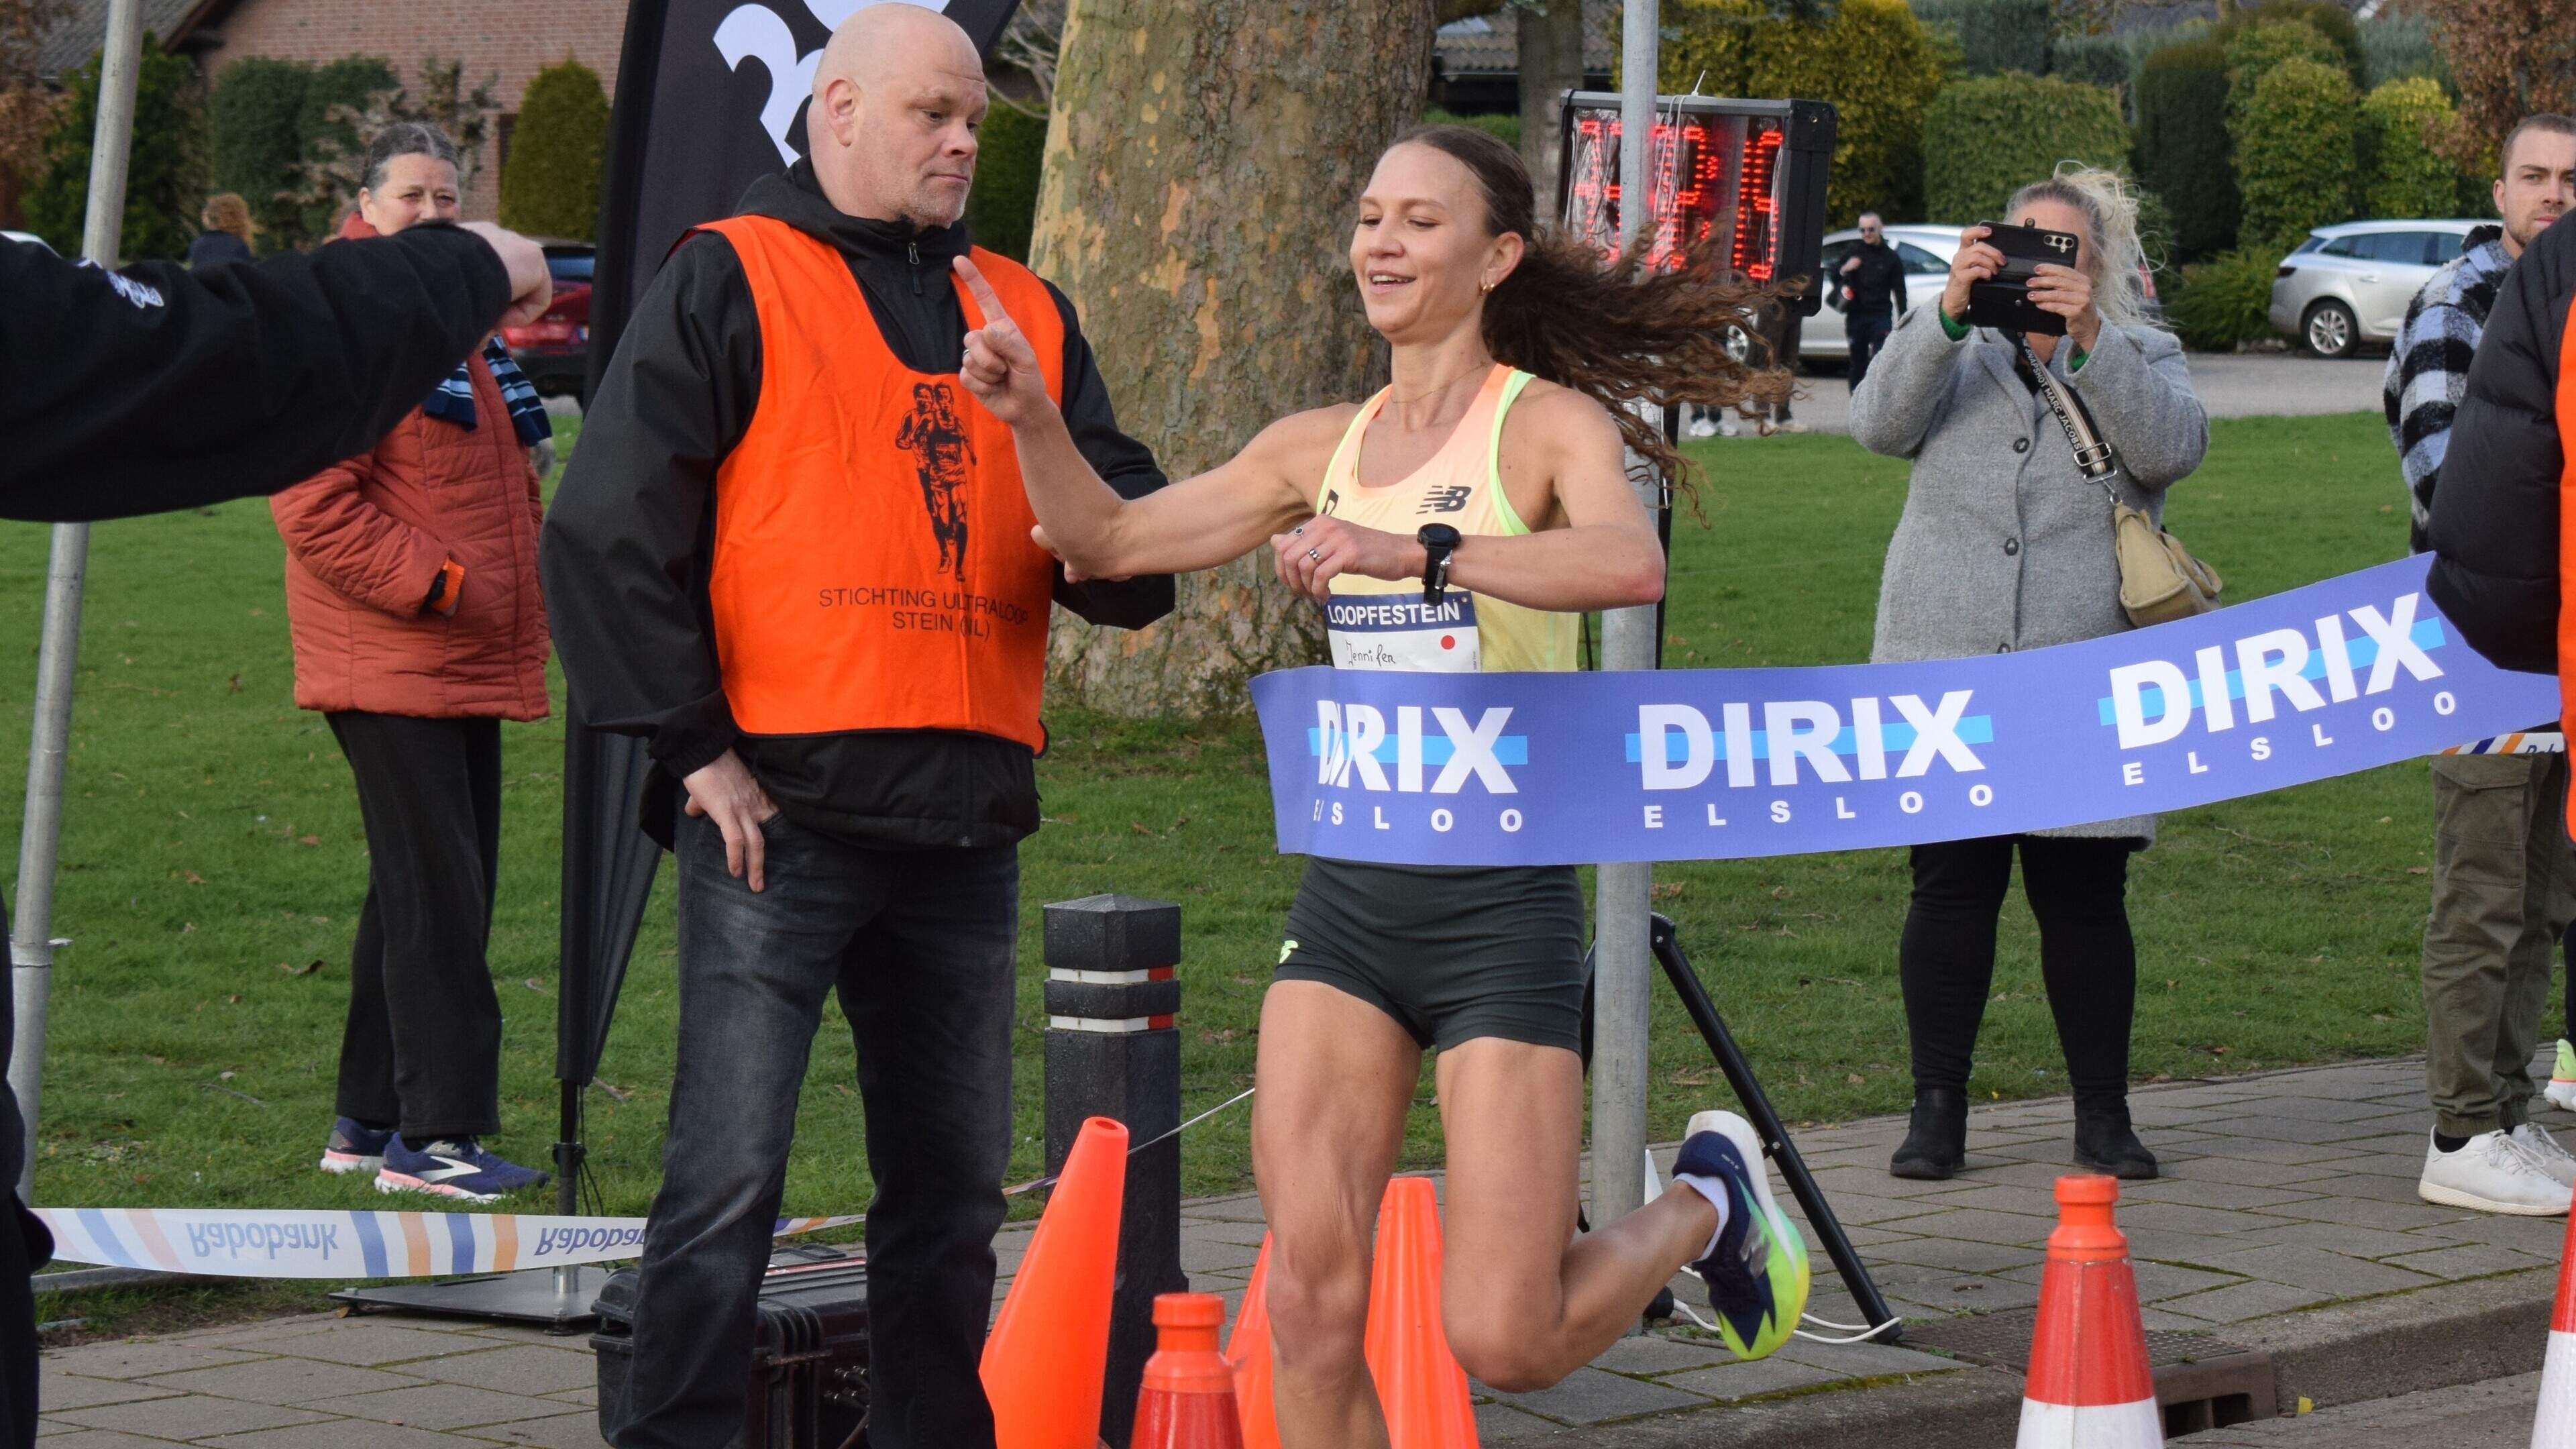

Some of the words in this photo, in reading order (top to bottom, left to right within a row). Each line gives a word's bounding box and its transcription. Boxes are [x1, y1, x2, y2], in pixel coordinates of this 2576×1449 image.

[2025, 348, 2047, 386] SNAPSHOT
[2044, 387, 2062, 413] MARC
[2058, 413, 2083, 450] JACOBS
[818, 588, 936, 608] STICHTING
[1328, 601, 1460, 625] LOOPFESTEIN
[892, 610, 953, 631] STEIN
[2109, 592, 2445, 750] DIRIX
[1638, 690, 1986, 790] DIRIX
[2122, 691, 2456, 786] ELSLOO
[1313, 799, 1523, 832] ESLOO
[1644, 784, 1994, 828] ELSLOO
